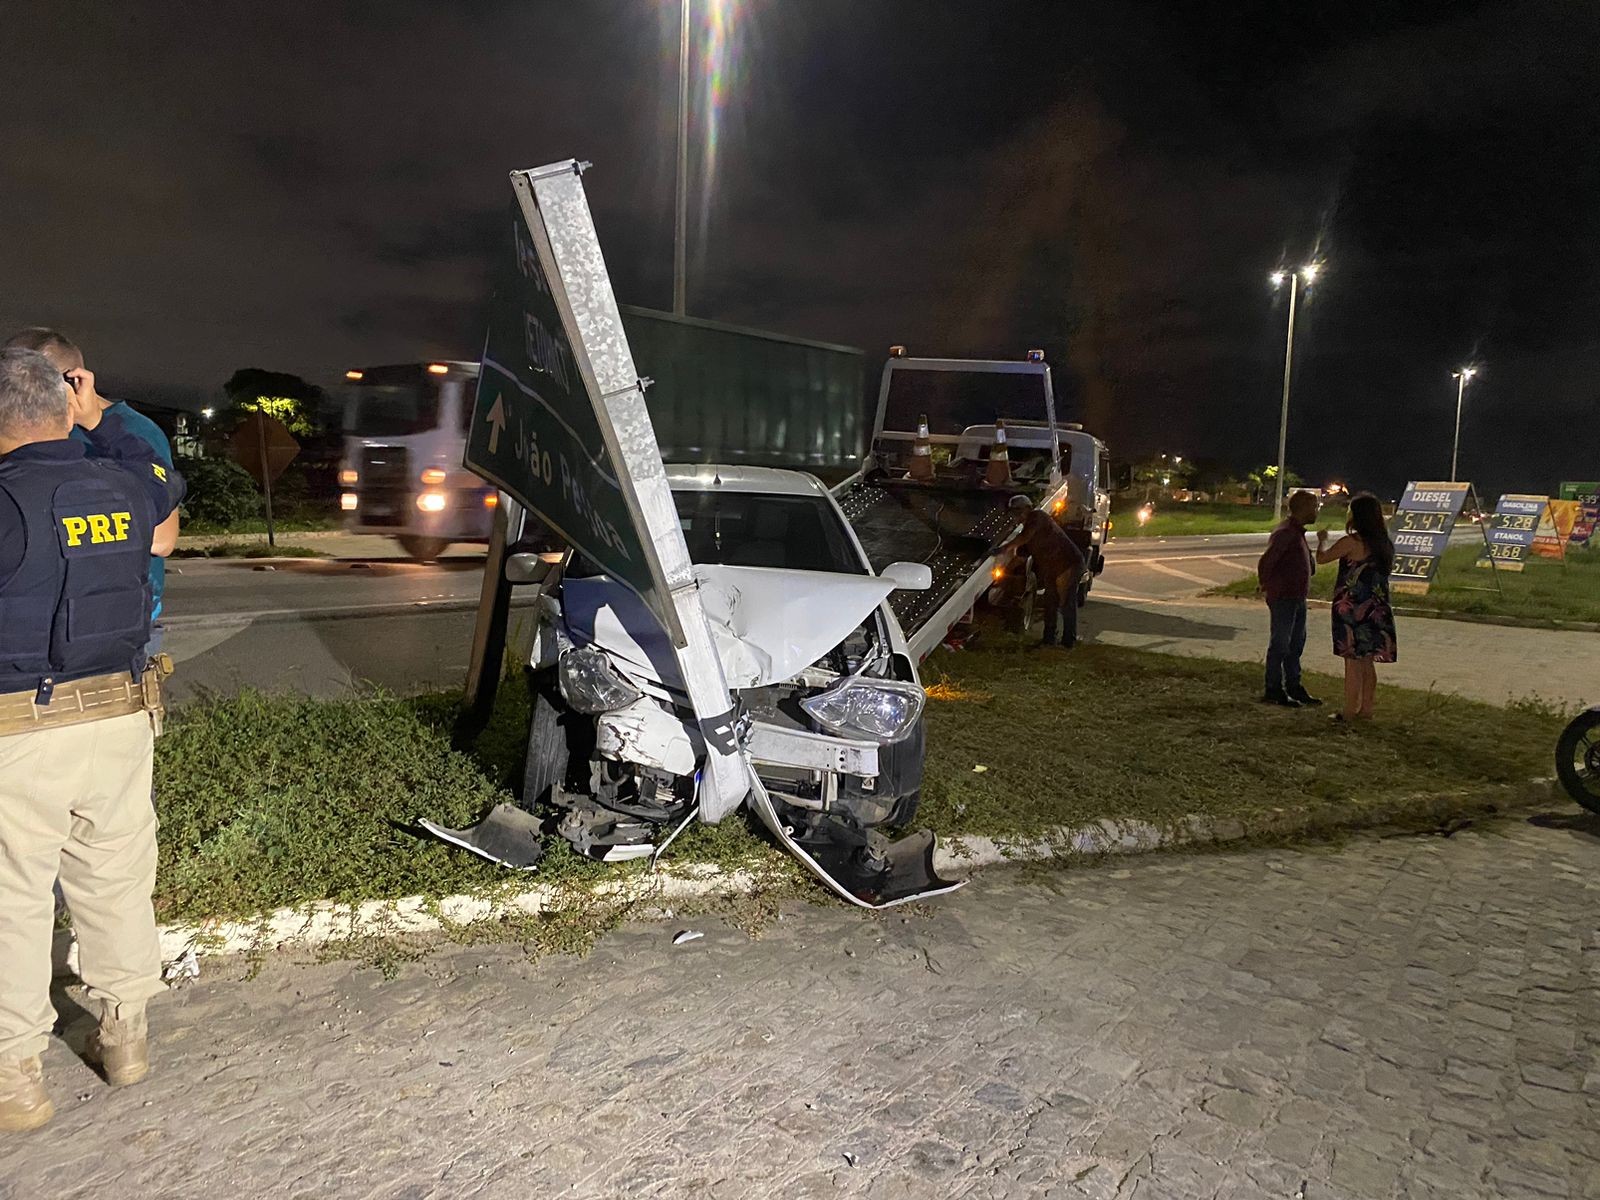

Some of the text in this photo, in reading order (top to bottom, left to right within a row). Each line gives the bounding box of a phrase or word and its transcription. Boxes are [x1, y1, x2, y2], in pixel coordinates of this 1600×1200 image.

[1412, 491, 1451, 502] DIESEL
[1502, 501, 1538, 509] GASOLINA
[62, 512, 132, 547] PRF
[1394, 535, 1434, 546] DIESEL
[1494, 532, 1524, 541] ETANOL
